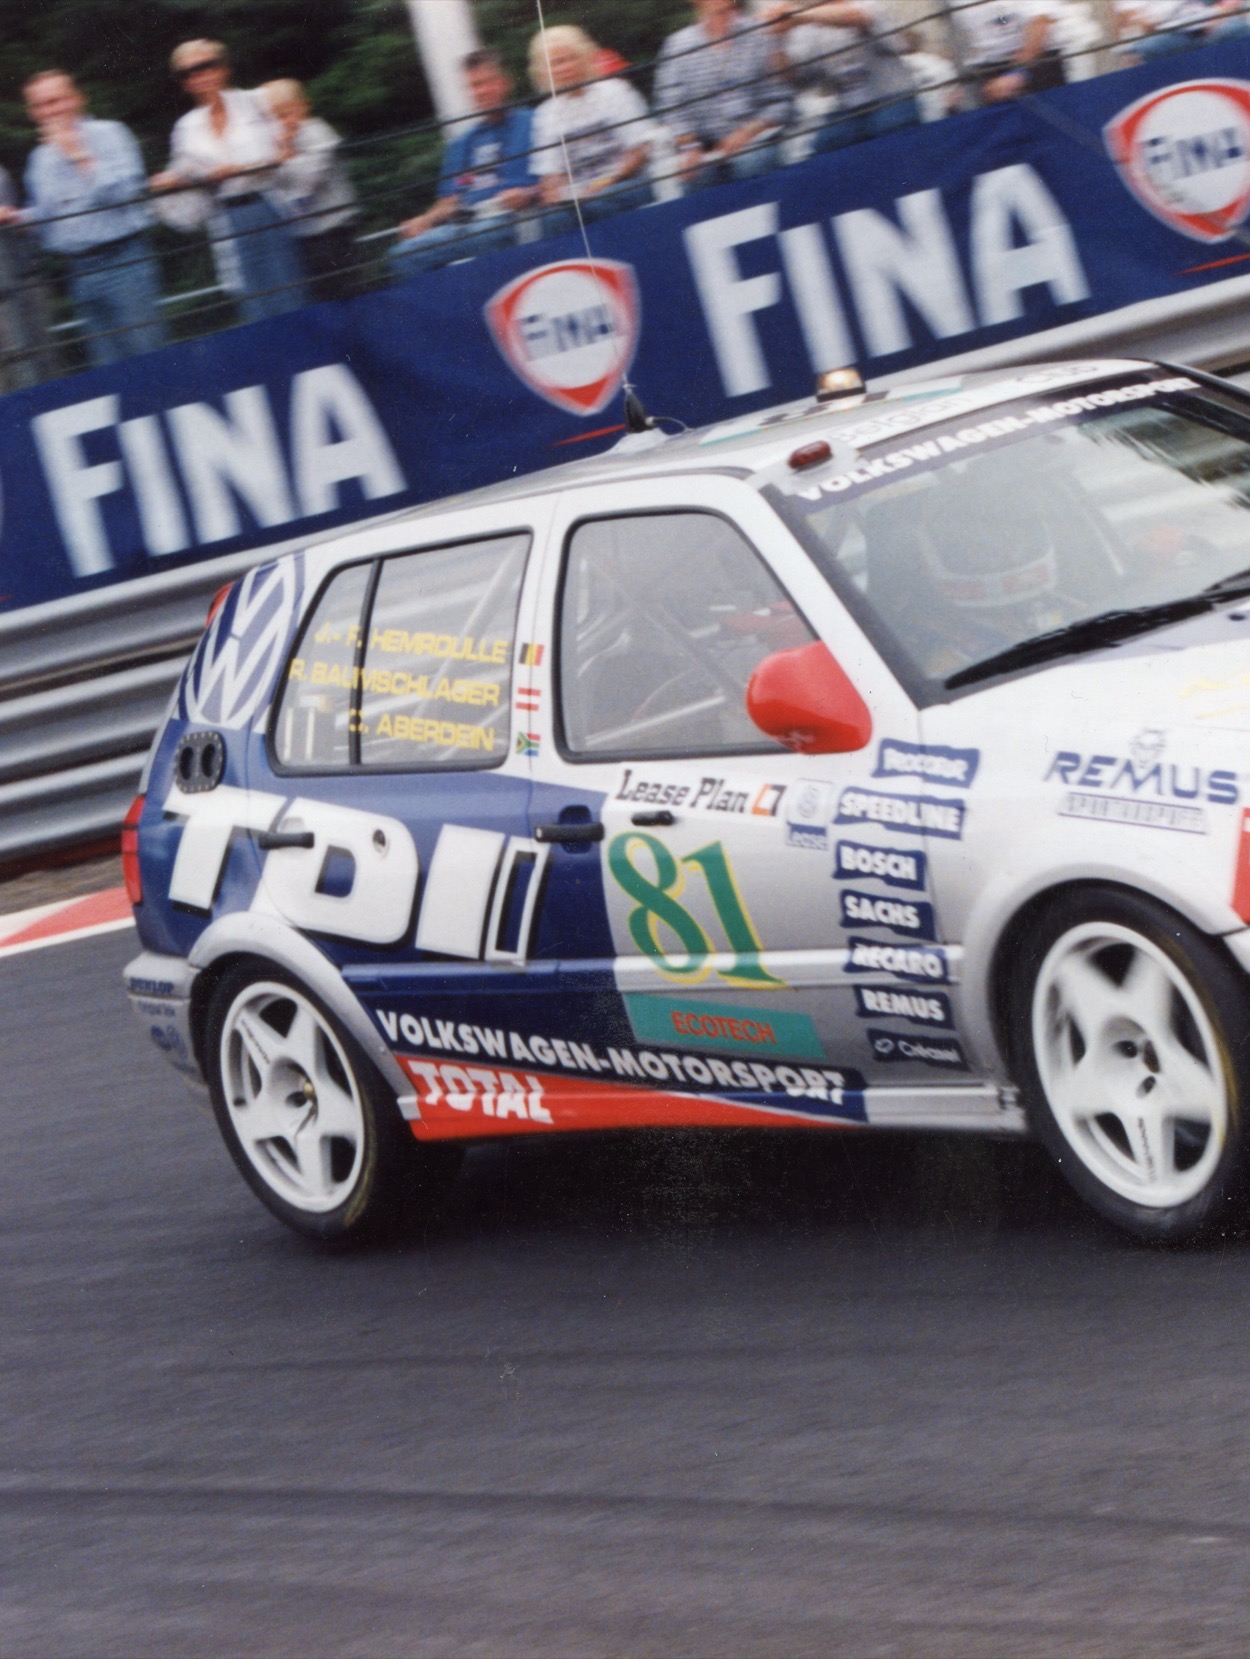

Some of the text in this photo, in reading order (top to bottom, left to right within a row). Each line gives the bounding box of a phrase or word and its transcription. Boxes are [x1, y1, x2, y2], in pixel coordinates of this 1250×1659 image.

[682, 163, 1090, 398] FINA
[30, 363, 408, 578] FINA
[311, 661, 500, 707] BAUMSCHLAGER
[376, 713, 495, 751] ABERDEIN
[615, 769, 750, 813] Lease Plan
[1043, 751, 1240, 805] REMUS
[840, 793, 962, 836] SPEEDLINE
[841, 846, 917, 882] BOSCH
[607, 831, 788, 990] 81
[845, 895, 920, 930] SACHS
[861, 990, 945, 1021] REMUS
[671, 1011, 777, 1045] ECOTECH
[407, 1059, 553, 1124] TOTAL
